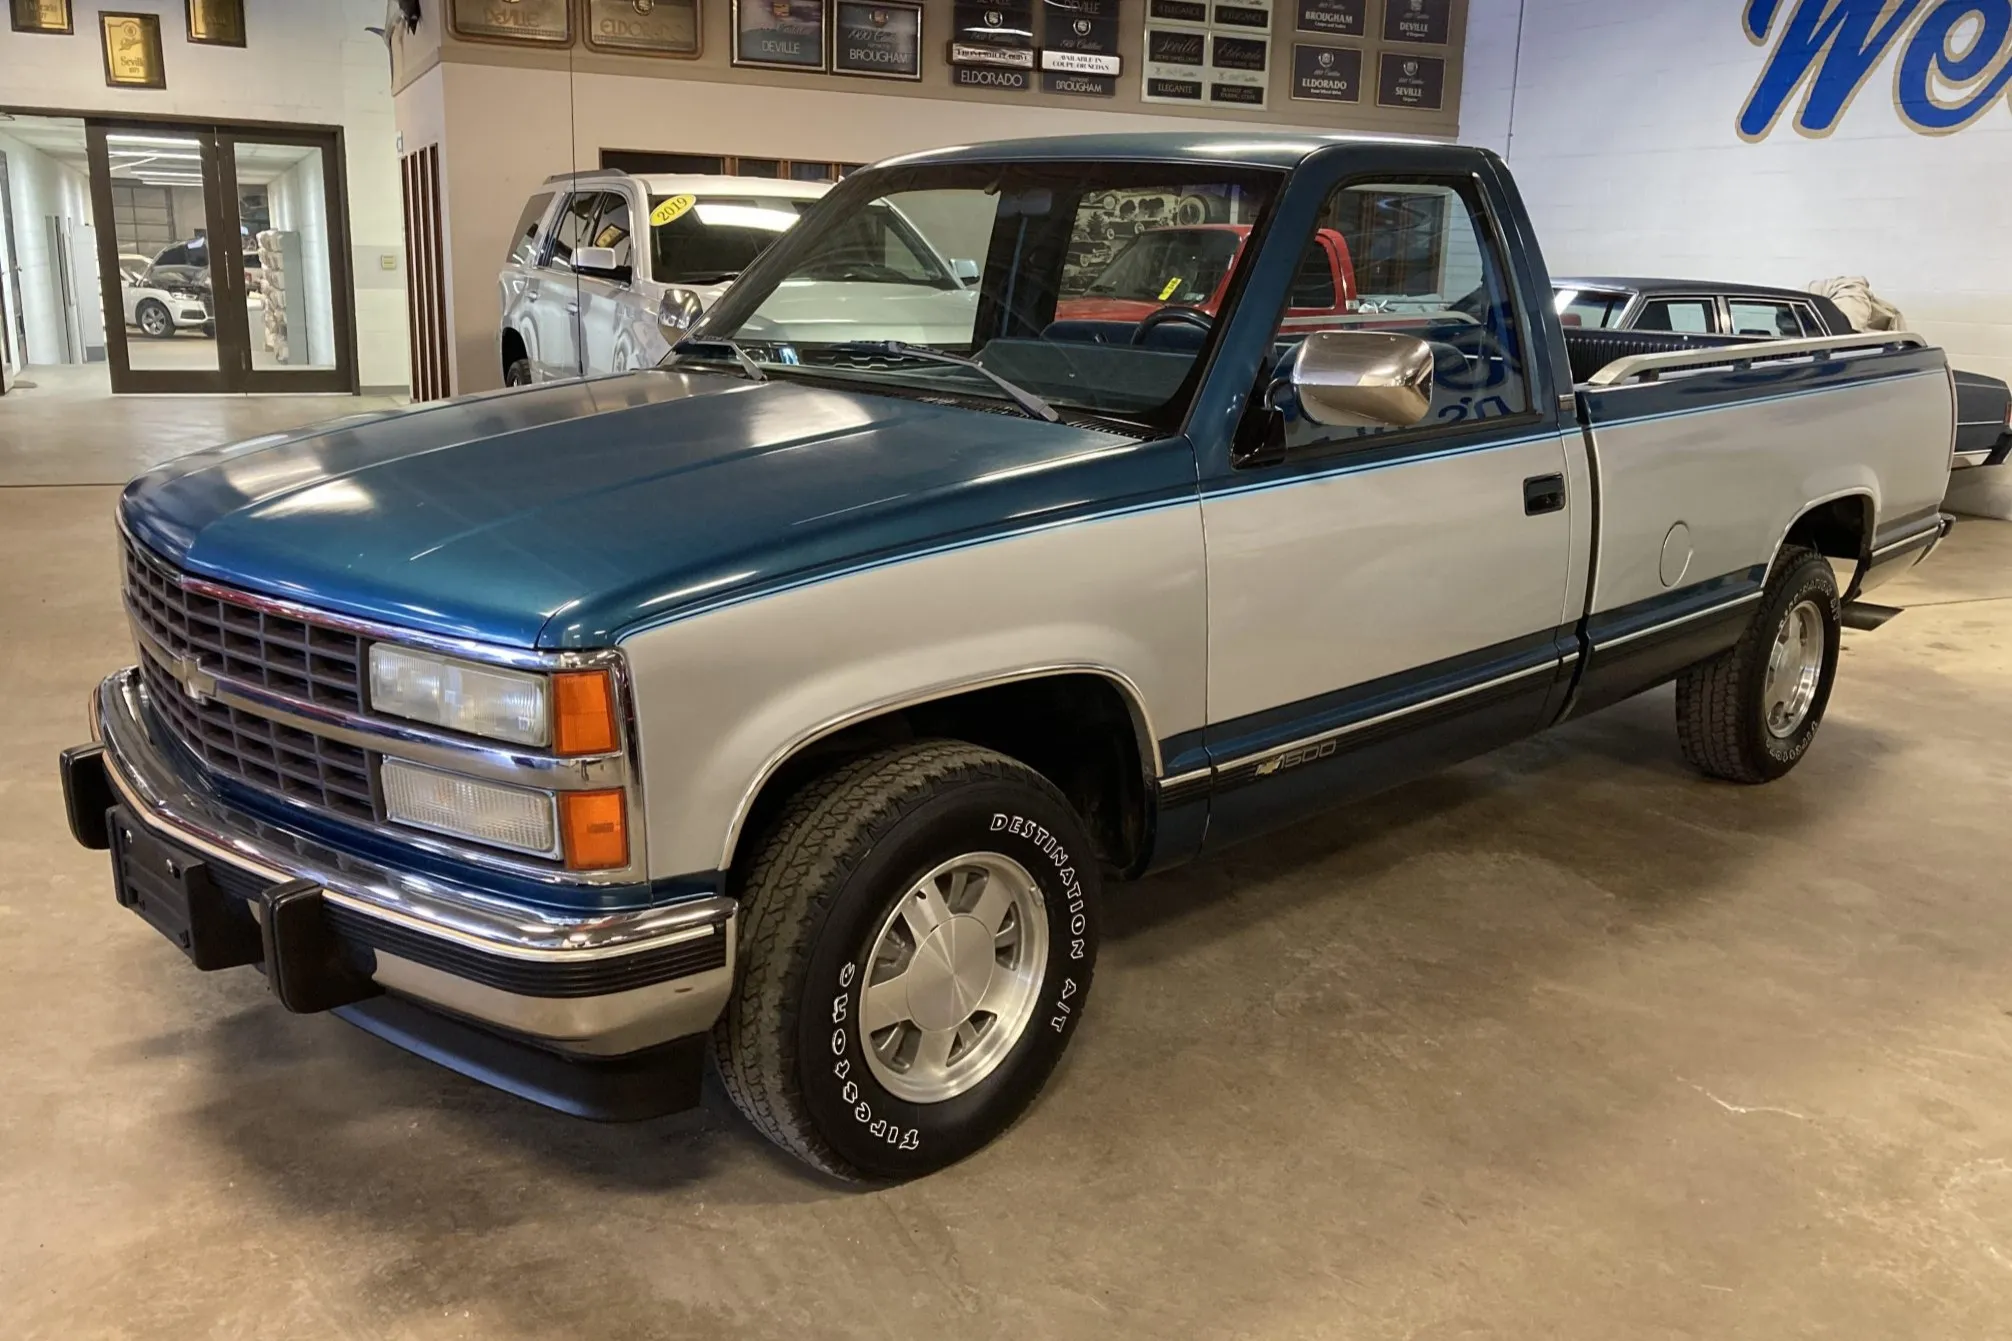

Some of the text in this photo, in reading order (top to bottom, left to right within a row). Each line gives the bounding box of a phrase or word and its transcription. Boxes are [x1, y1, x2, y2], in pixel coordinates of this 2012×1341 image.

[1305, 11, 1352, 24] BROUGHAM
[1400, 21, 1428, 32] DEVILLE
[761, 40, 801, 55] DEVILLE
[849, 48, 909, 64] BROUGHAM
[961, 70, 1023, 87] ELDORADO
[1302, 78, 1348, 90] ELDORADO
[1056, 80, 1102, 93] BROUGHAM
[1158, 83, 1193, 94] ELEGANTE
[1396, 86, 1422, 97] SEVILLE
[657, 197, 688, 222] 2019
[1275, 739, 1337, 769] 1500
[989, 813, 1086, 1033] DESTINATION A/T
[832, 962, 919, 1150] Firestone
